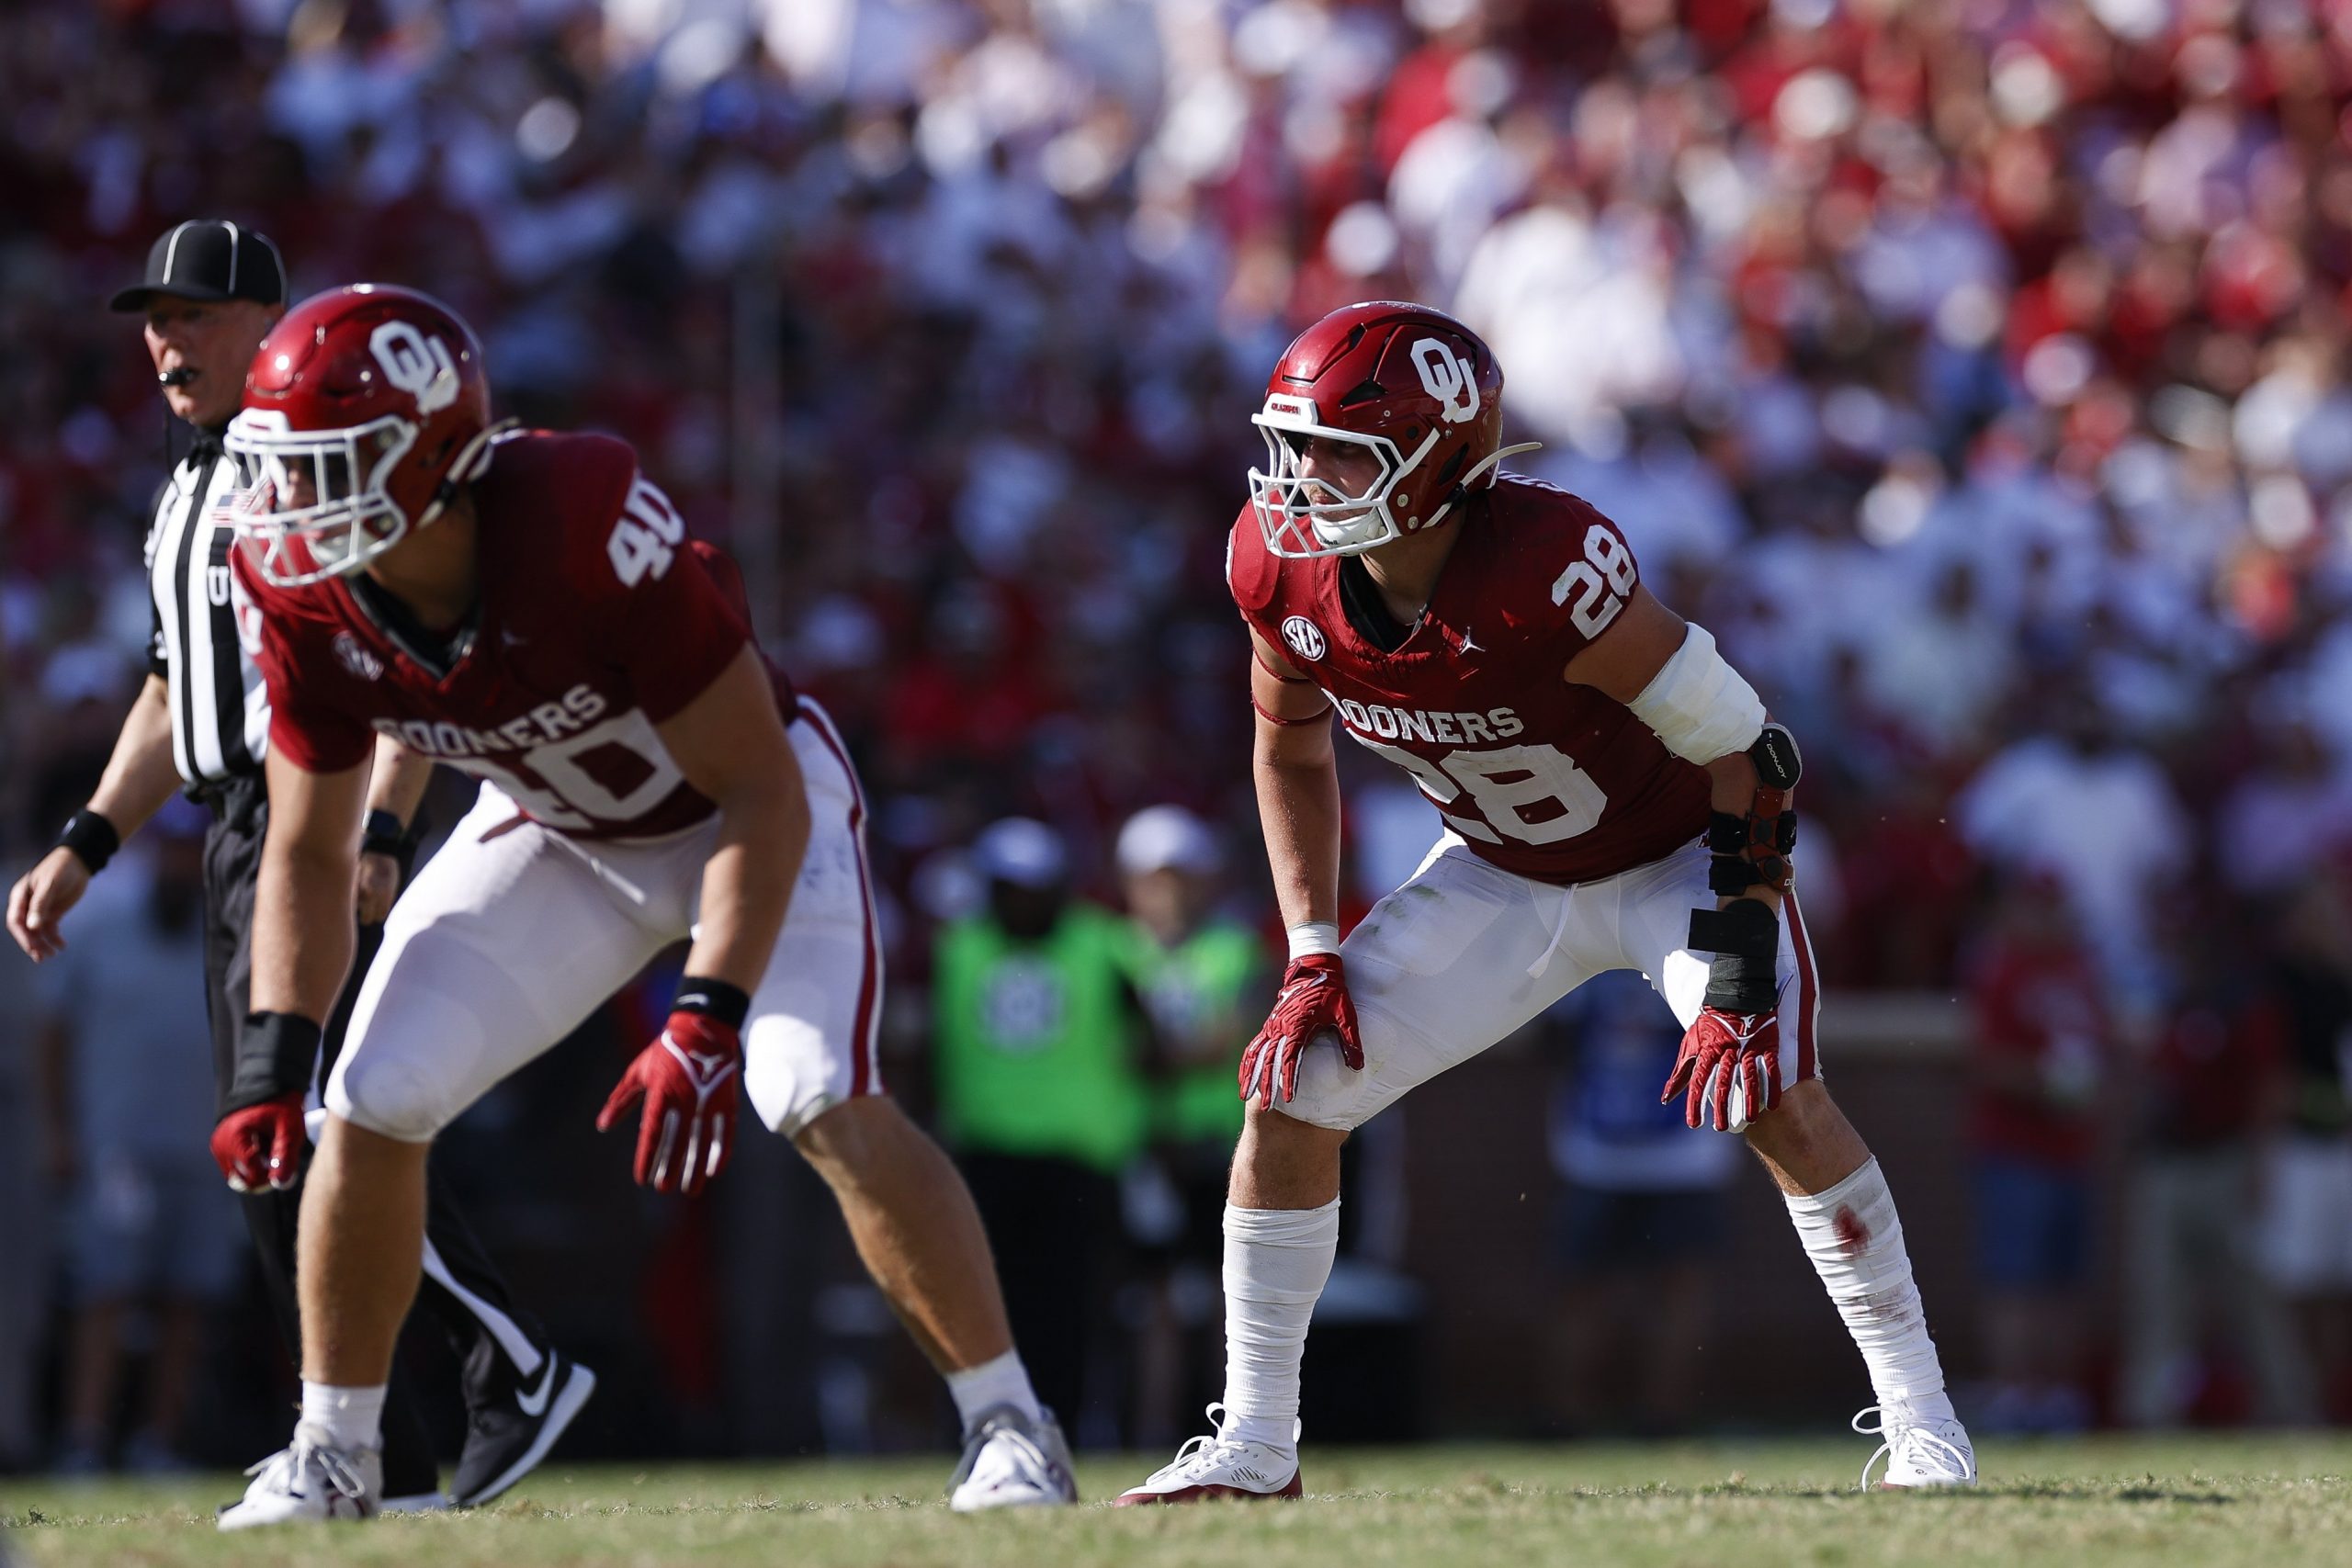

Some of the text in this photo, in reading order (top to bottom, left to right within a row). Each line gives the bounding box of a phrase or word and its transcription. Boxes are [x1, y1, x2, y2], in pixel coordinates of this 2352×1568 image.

[368, 320, 460, 414] OU
[1410, 337, 1480, 423] OU
[606, 474, 685, 589] 40
[208, 566, 230, 606] U
[1552, 525, 1636, 640] 28
[1285, 619, 1322, 658] SEC
[1346, 725, 1608, 846] 28
[1767, 743, 1787, 779] DONJOY
